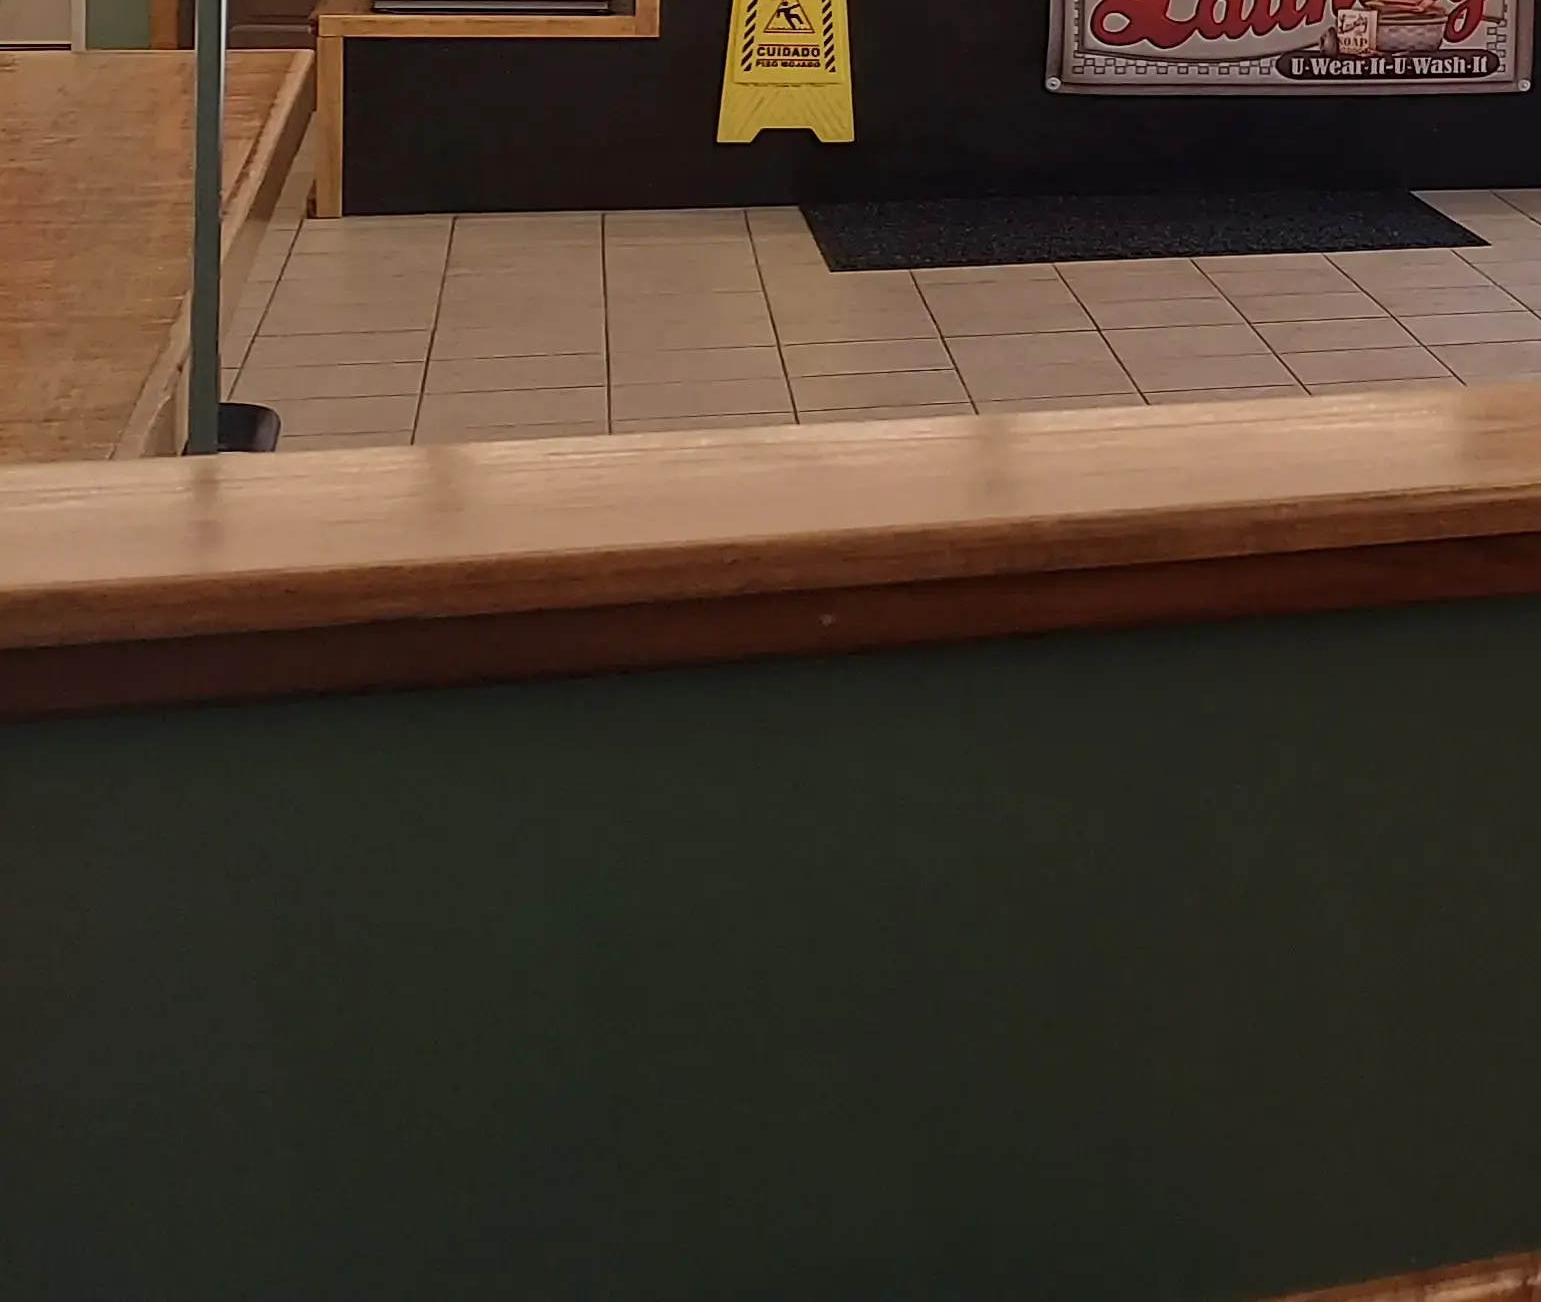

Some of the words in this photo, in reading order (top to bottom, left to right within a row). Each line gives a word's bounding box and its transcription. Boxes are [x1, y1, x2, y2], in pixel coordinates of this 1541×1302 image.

[756, 46, 821, 58] CUIDADO
[756, 59, 779, 68] PISO
[781, 59, 821, 68] MOJADO
[1290, 56, 1489, 78] U-Wear-It-U-Wash-It
